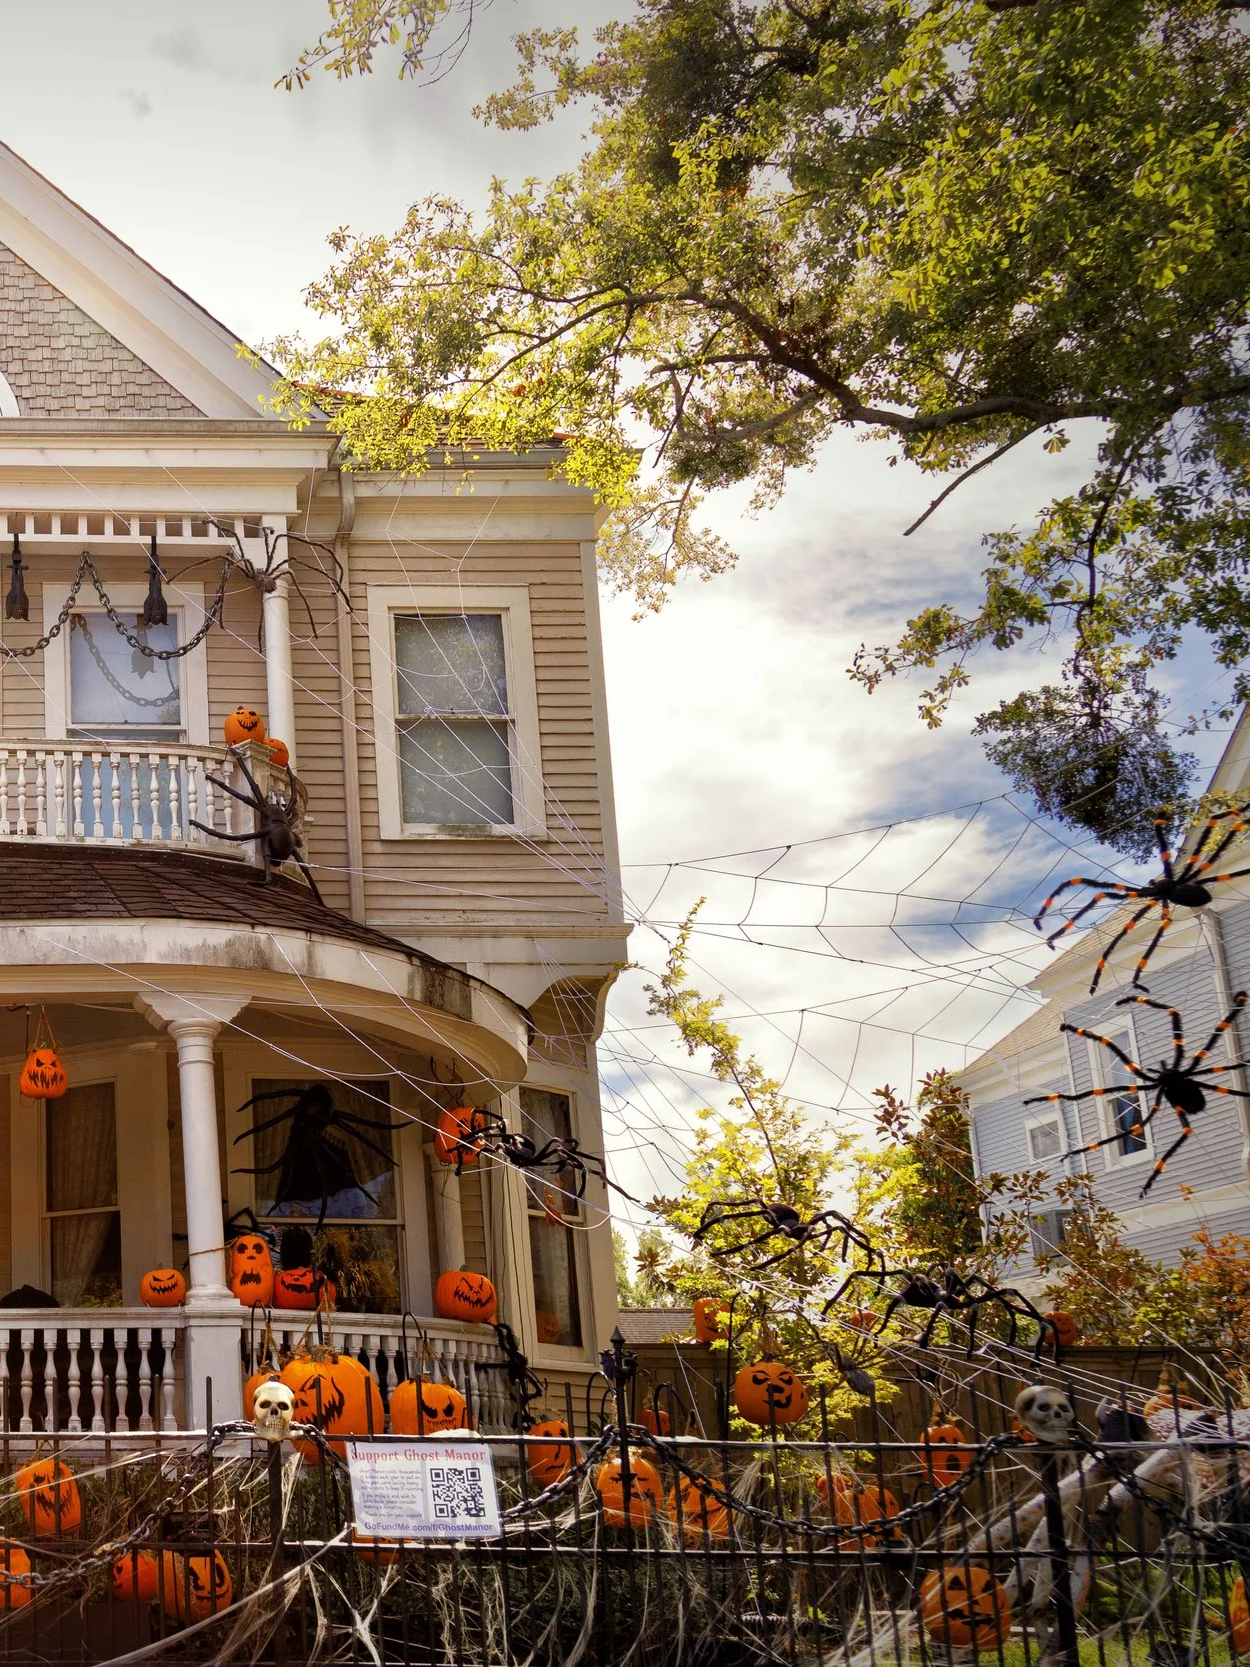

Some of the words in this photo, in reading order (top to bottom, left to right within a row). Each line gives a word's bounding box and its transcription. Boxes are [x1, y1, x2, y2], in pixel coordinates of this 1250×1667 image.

[351, 1450, 399, 1463] Support
[404, 1450, 439, 1462] Ghost
[445, 1449, 486, 1461] Manor
